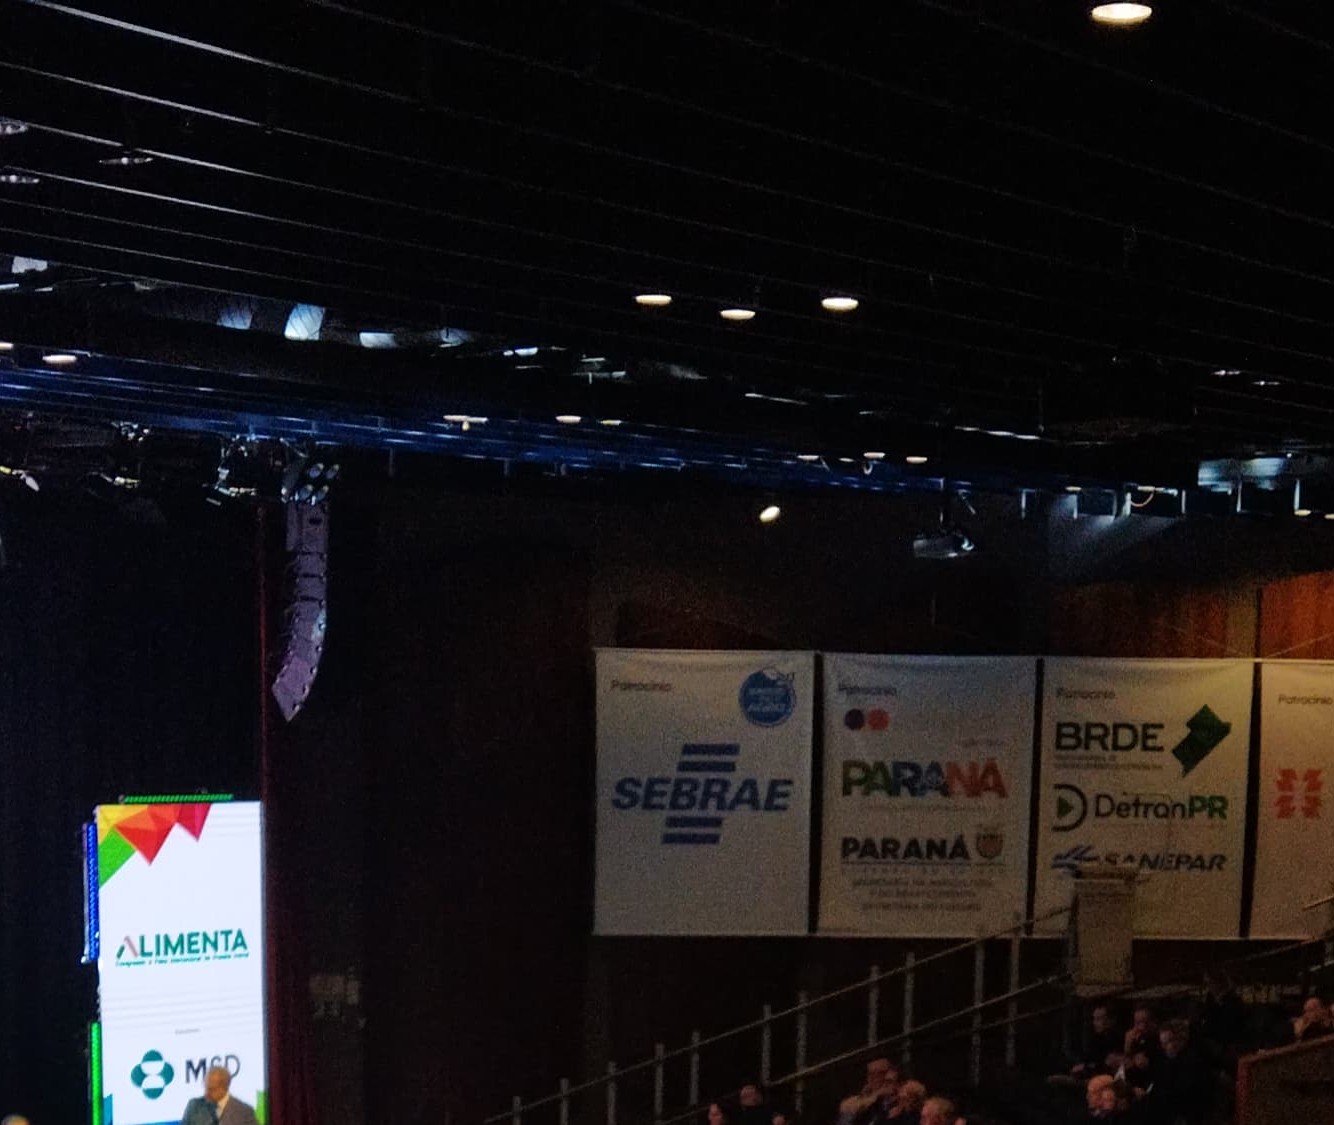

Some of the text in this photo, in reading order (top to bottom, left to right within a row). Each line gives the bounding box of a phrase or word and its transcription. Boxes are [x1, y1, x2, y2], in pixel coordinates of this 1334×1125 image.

[1055, 722, 1165, 752] BRDE
[611, 777, 794, 812] SEBRAE
[1095, 794, 1229, 819] DetranPR
[841, 831, 969, 860] PARANÁ
[116, 928, 248, 959] ALIMENTA
